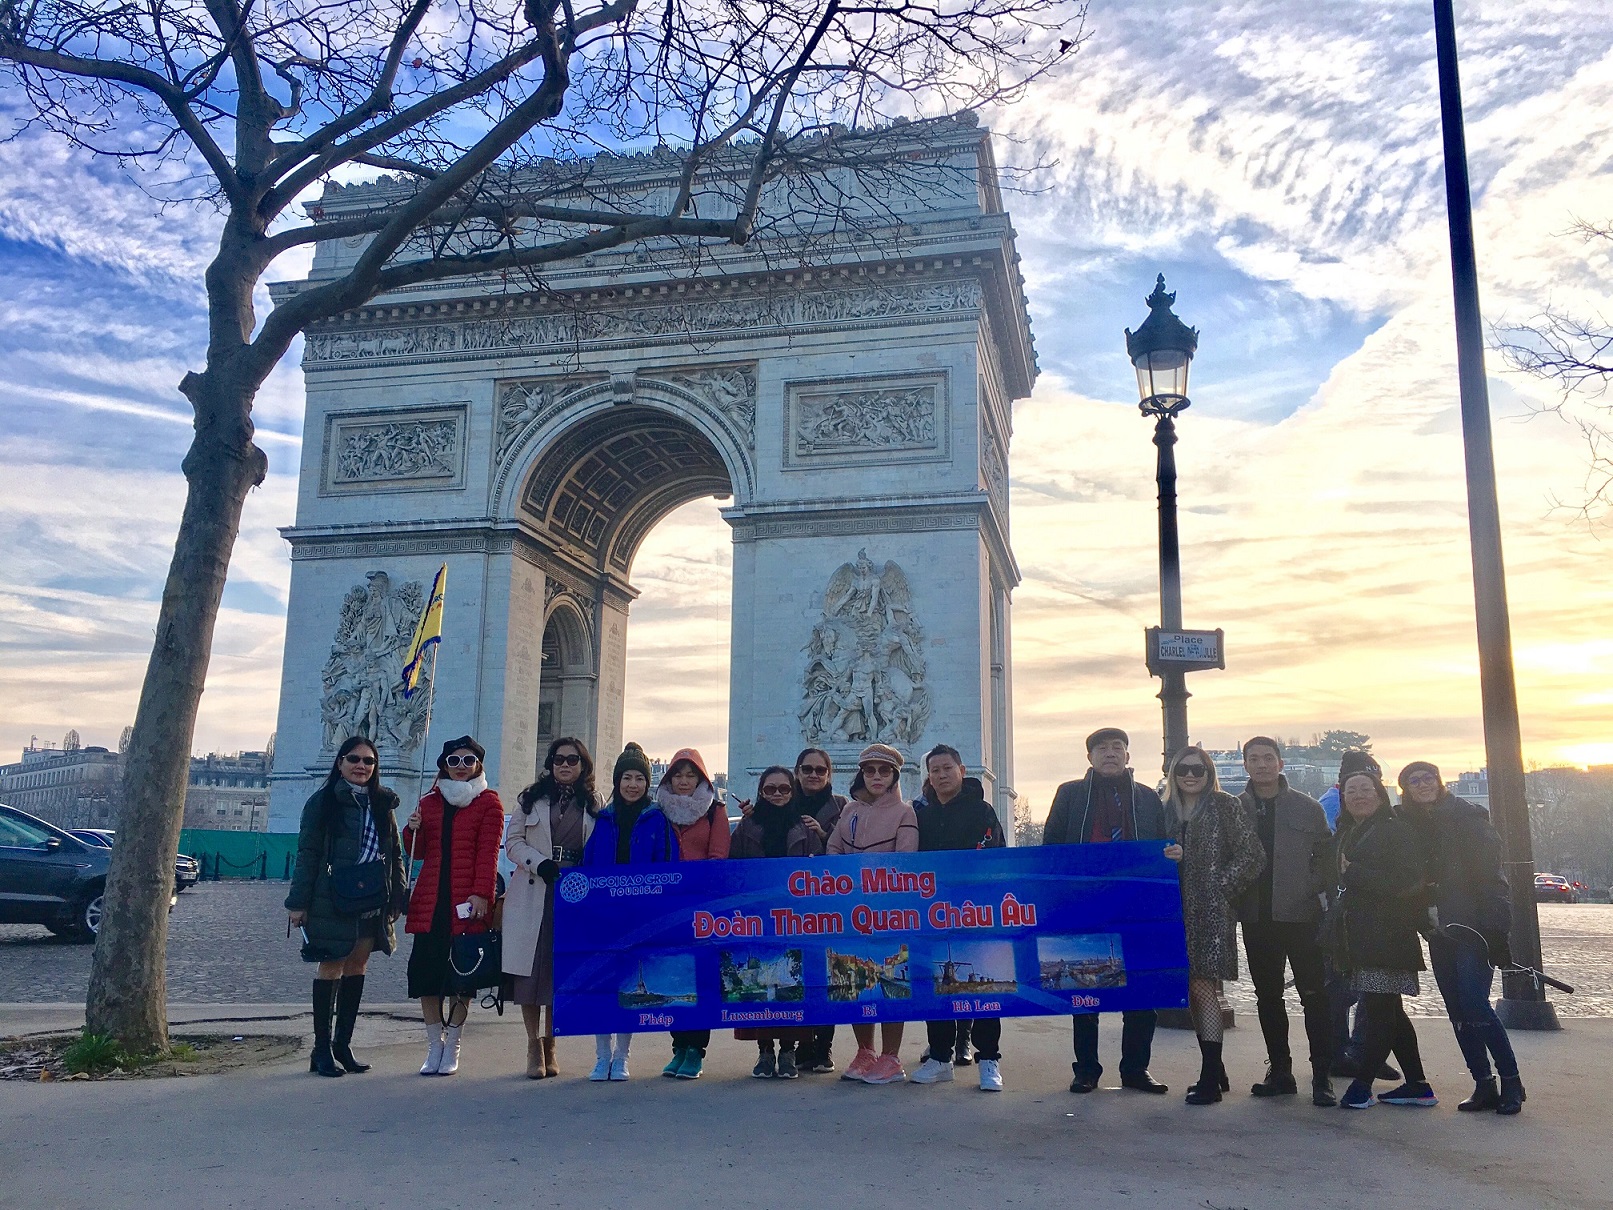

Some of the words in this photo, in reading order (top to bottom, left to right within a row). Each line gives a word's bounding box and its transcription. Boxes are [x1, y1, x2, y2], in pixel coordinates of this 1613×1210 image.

[1174, 635, 1203, 644] Place
[645, 872, 683, 885] GROUP
[788, 869, 853, 898] Chào
[610, 885, 663, 897] TOURISM
[692, 910, 763, 939] Đoàn
[770, 908, 844, 937] Tham
[851, 904, 921, 934] Quan
[928, 900, 994, 929] Châu
[1001, 892, 1037, 927] Âu
[952, 1000, 972, 1013] Hà
[975, 1000, 1001, 1012] Lan
[639, 1013, 674, 1026] Pháp
[721, 1008, 804, 1022] Luxembourg
